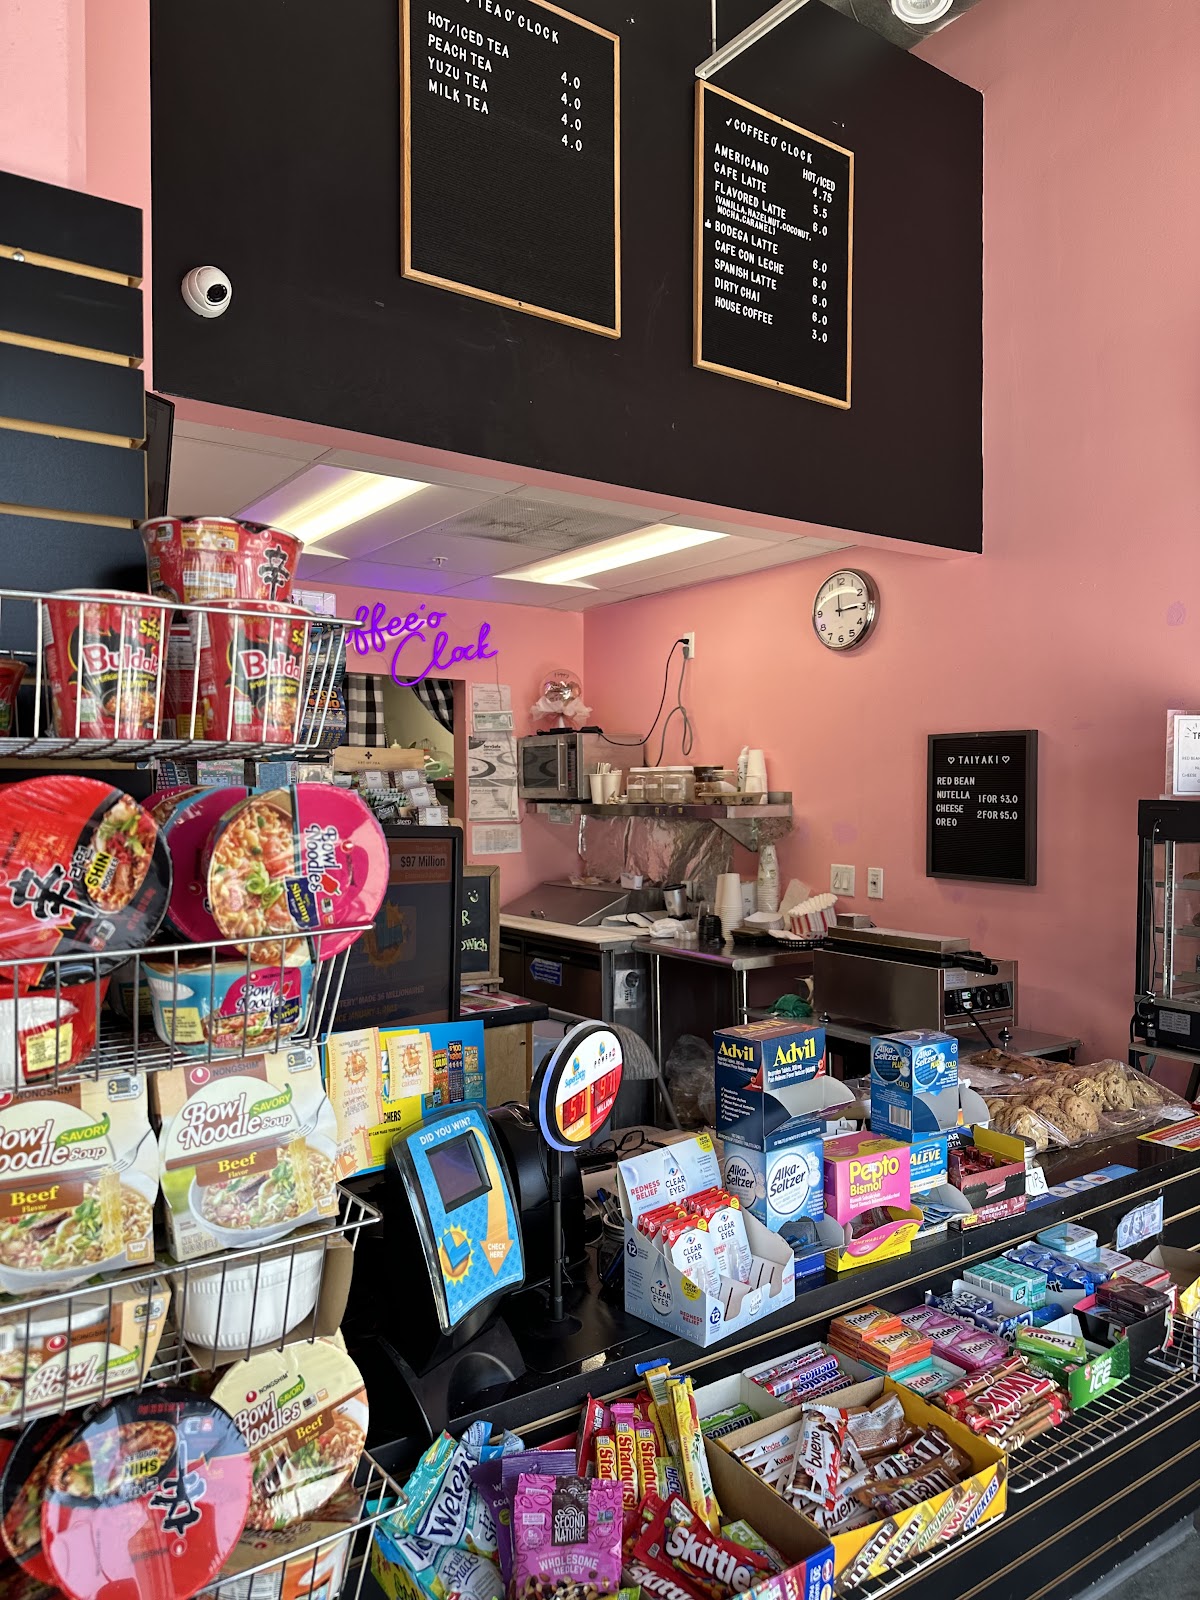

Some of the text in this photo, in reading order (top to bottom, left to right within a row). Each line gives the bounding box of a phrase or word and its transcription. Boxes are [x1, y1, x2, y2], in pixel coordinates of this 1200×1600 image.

[428, 10, 510, 58] HOT/ICED TEA
[428, 34, 492, 72] PEACH TEA
[428, 56, 488, 92] YUZU TEA
[561, 72, 580, 89] 4.0
[428, 79, 489, 114] MILK TEA
[561, 93, 581, 110] 4.0
[561, 113, 582, 130] 4.0
[734, 118, 769, 144] COFFEE
[562, 134, 583, 152] 4.0
[714, 143, 769, 176] AMERICANO
[714, 162, 767, 193] CAFE LATTE
[802, 168, 836, 192] HOT/ICED
[714, 180, 786, 220] FLAVORED LATTE
[812, 187, 832, 204] 4.75
[812, 204, 828, 218] 5.5
[714, 220, 778, 254] BODEGA LATTE
[812, 222, 828, 236] 6.0
[714, 240, 784, 275] CAFE CON LECHE
[714, 258, 777, 290] SPANISH LATTE
[812, 259, 828, 274] 6.0
[714, 276, 760, 302] DIRTY CHAI
[812, 277, 827, 290] 6.0
[812, 294, 827, 308] 6.0
[714, 296, 774, 325] HOUSE COFFEE
[812, 312, 828, 326] 6.0
[812, 329, 828, 343] 3.0
[392, 622, 498, 687] Clock
[958, 756, 998, 764] TAIYAKI
[937, 776, 975, 786] RED BEAN
[936, 790, 970, 800] NUTELLA
[1000, 794, 1018, 804] $3.0
[936, 804, 964, 814] CHEESE
[1000, 810, 1018, 820] $5.0
[936, 818, 958, 827] OREO
[322, 826, 342, 871] Bowl
[304, 824, 324, 892] Noodles
[400, 855, 446, 868] $97 Million
[87, 852, 110, 887] SHIN
[718, 1041, 754, 1062] Advil
[773, 1037, 816, 1067] Advil
[874, 1052, 900, 1060] Seltzer
[878, 1046, 895, 1055] Alka-
[918, 1049, 934, 1060] Alka-
[212, 1061, 260, 1077] NONGSHIM
[916, 1054, 938, 1068] Seltzer
[946, 1060, 956, 1068] COLD
[183, 1092, 246, 1127] Bowl
[253, 1093, 290, 1114] SAVORY
[596, 1098, 612, 1114] MILLION
[0, 1120, 54, 1150] owl
[60, 1124, 108, 1145] SAVORY
[178, 1113, 292, 1150] Noodle Soup
[419, 1116, 471, 1145] DID YOU WIN?
[68, 1146, 106, 1161] Soup
[910, 1149, 941, 1166] ALEVE
[218, 1152, 257, 1173] Beef
[728, 1164, 749, 1177] Alka-
[849, 1154, 899, 1184] Pepto
[228, 1168, 248, 1179] Flavor
[665, 1174, 686, 1188] CLEAR
[726, 1174, 754, 1188] Seltzer
[772, 1164, 800, 1184] Alka-
[630, 1180, 660, 1196] REDNESS
[670, 1184, 686, 1196] EYES
[770, 1172, 806, 1198] Seltzer
[850, 1178, 882, 1196] Bismol
[10, 1186, 60, 1206] Beef
[636, 1190, 658, 1201] RELIEF
[22, 1203, 48, 1214] Flavor
[982, 1204, 1008, 1214] REGULAR
[718, 1220, 735, 1234] CLEAR
[721, 1230, 734, 1240] EYES
[488, 1242, 506, 1251] CHECK
[490, 1250, 504, 1258] HERE
[628, 1244, 637, 1254] 12
[683, 1244, 702, 1256] CLEAR
[686, 1252, 702, 1264] EYES
[650, 1286, 672, 1300] CLEAR
[652, 1295, 669, 1307] EYES
[680, 1310, 702, 1322] REDNESS
[711, 1313, 720, 1322] 12
[846, 1310, 880, 1327] Trident
[902, 1310, 933, 1326] Trident
[875, 1331, 911, 1346] Trident
[928, 1324, 964, 1340] Trident
[960, 1338, 996, 1356] Trident
[1028, 1333, 1078, 1349] Trident
[800, 1360, 836, 1383] mentos
[258, 1372, 289, 1395] NONGSHIM
[908, 1371, 942, 1390] Trident
[1089, 1372, 1112, 1394] ICE
[278, 1381, 306, 1404] SAVORY
[974, 1370, 1050, 1417] TWIX
[234, 1392, 277, 1432] Bowl
[296, 1414, 324, 1440] Beef
[761, 1442, 781, 1454] kinder
[805, 1431, 821, 1469] bueno
[415, 1450, 479, 1538] Welch's
[963, 1479, 998, 1531] SNICKERS
[555, 1512, 586, 1530] SECOND
[938, 1490, 977, 1542] TWIX
[554, 1528, 586, 1544] NATURE
[443, 1550, 466, 1577] Fruit
[538, 1554, 600, 1572] WHOLESOME
[666, 1526, 753, 1594] Skittle
[448, 1554, 480, 1588] Snacks
[554, 1565, 586, 1576] MEDLEY
